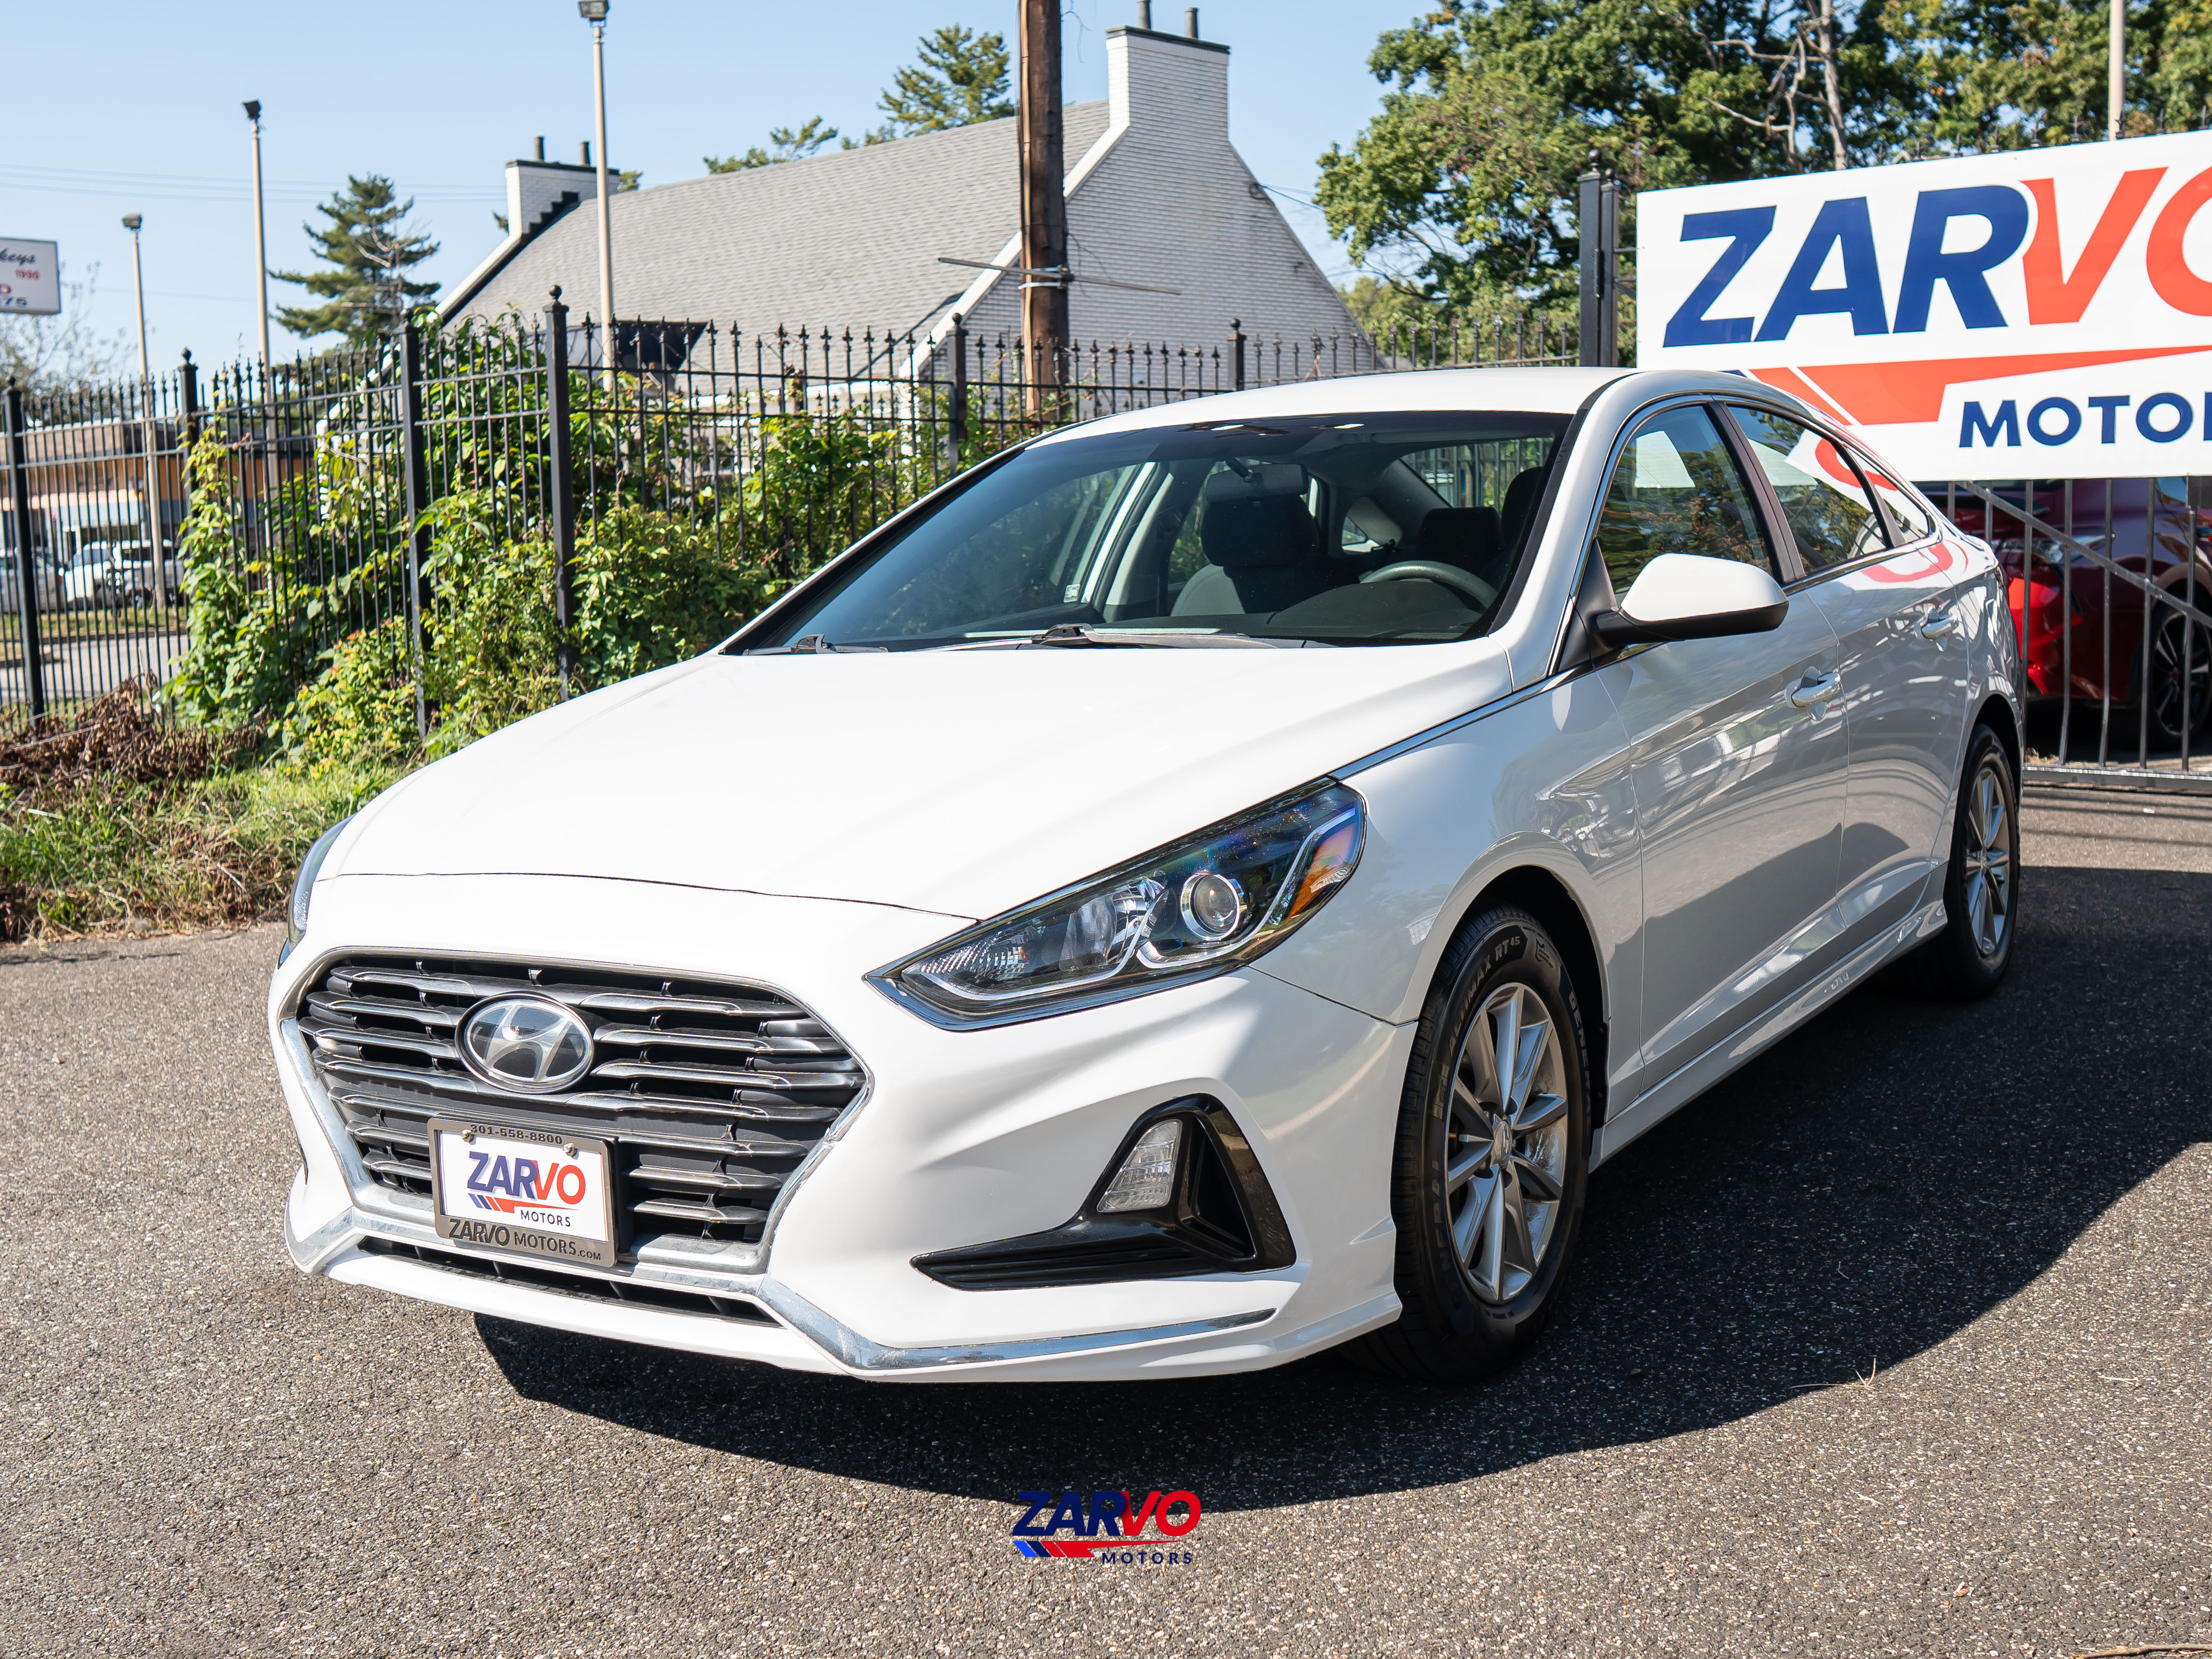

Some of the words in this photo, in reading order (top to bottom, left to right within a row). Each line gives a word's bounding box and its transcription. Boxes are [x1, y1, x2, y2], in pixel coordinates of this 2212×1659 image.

[1959, 392, 2212, 447] MOTO
[470, 1124, 563, 1145] 301-558-8800
[468, 1151, 586, 1205] ZARVO
[448, 1218, 510, 1247] ZARVO
[520, 1209, 571, 1227] MOTORS
